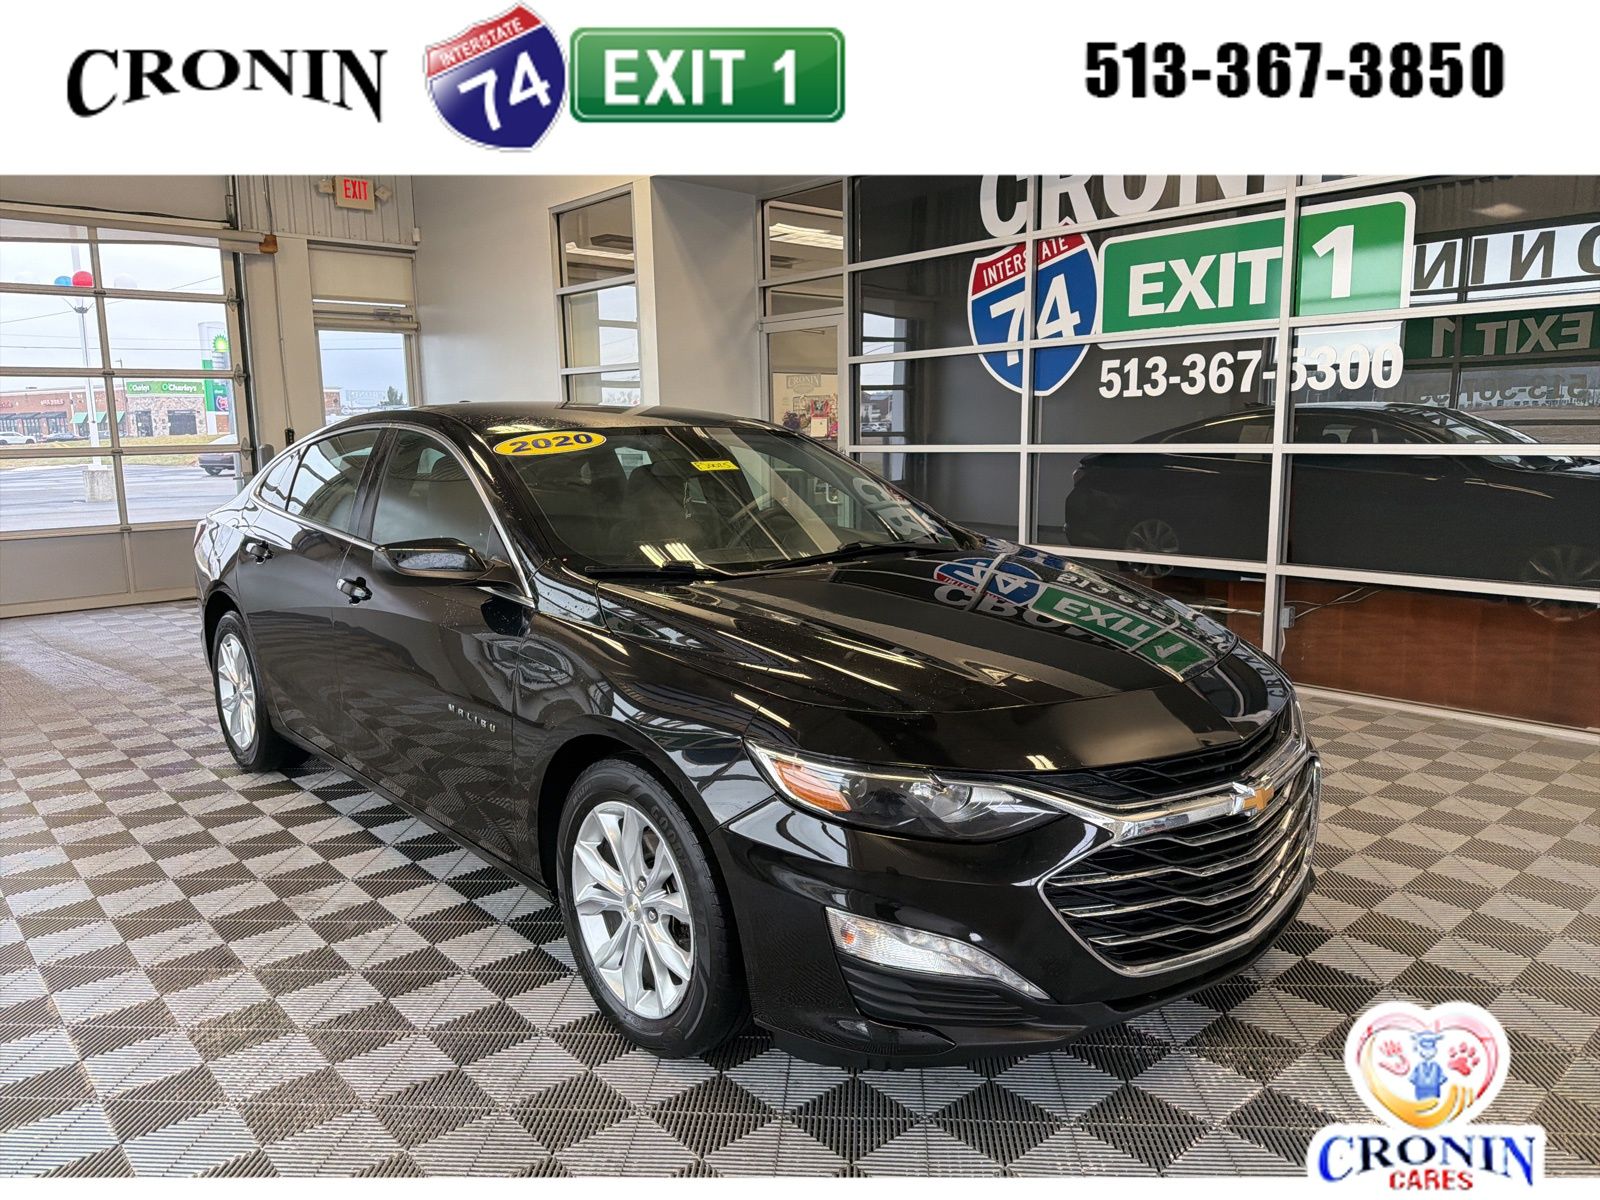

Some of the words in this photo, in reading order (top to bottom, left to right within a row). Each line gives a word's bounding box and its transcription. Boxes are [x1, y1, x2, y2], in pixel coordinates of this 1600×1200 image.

[343, 177, 369, 201] EXIT
[1128, 246, 1283, 317] EXIT
[1311, 224, 1355, 299] 1
[989, 273, 1081, 367] 74
[509, 433, 593, 453] 2020
[448, 703, 496, 733] MALIBU
